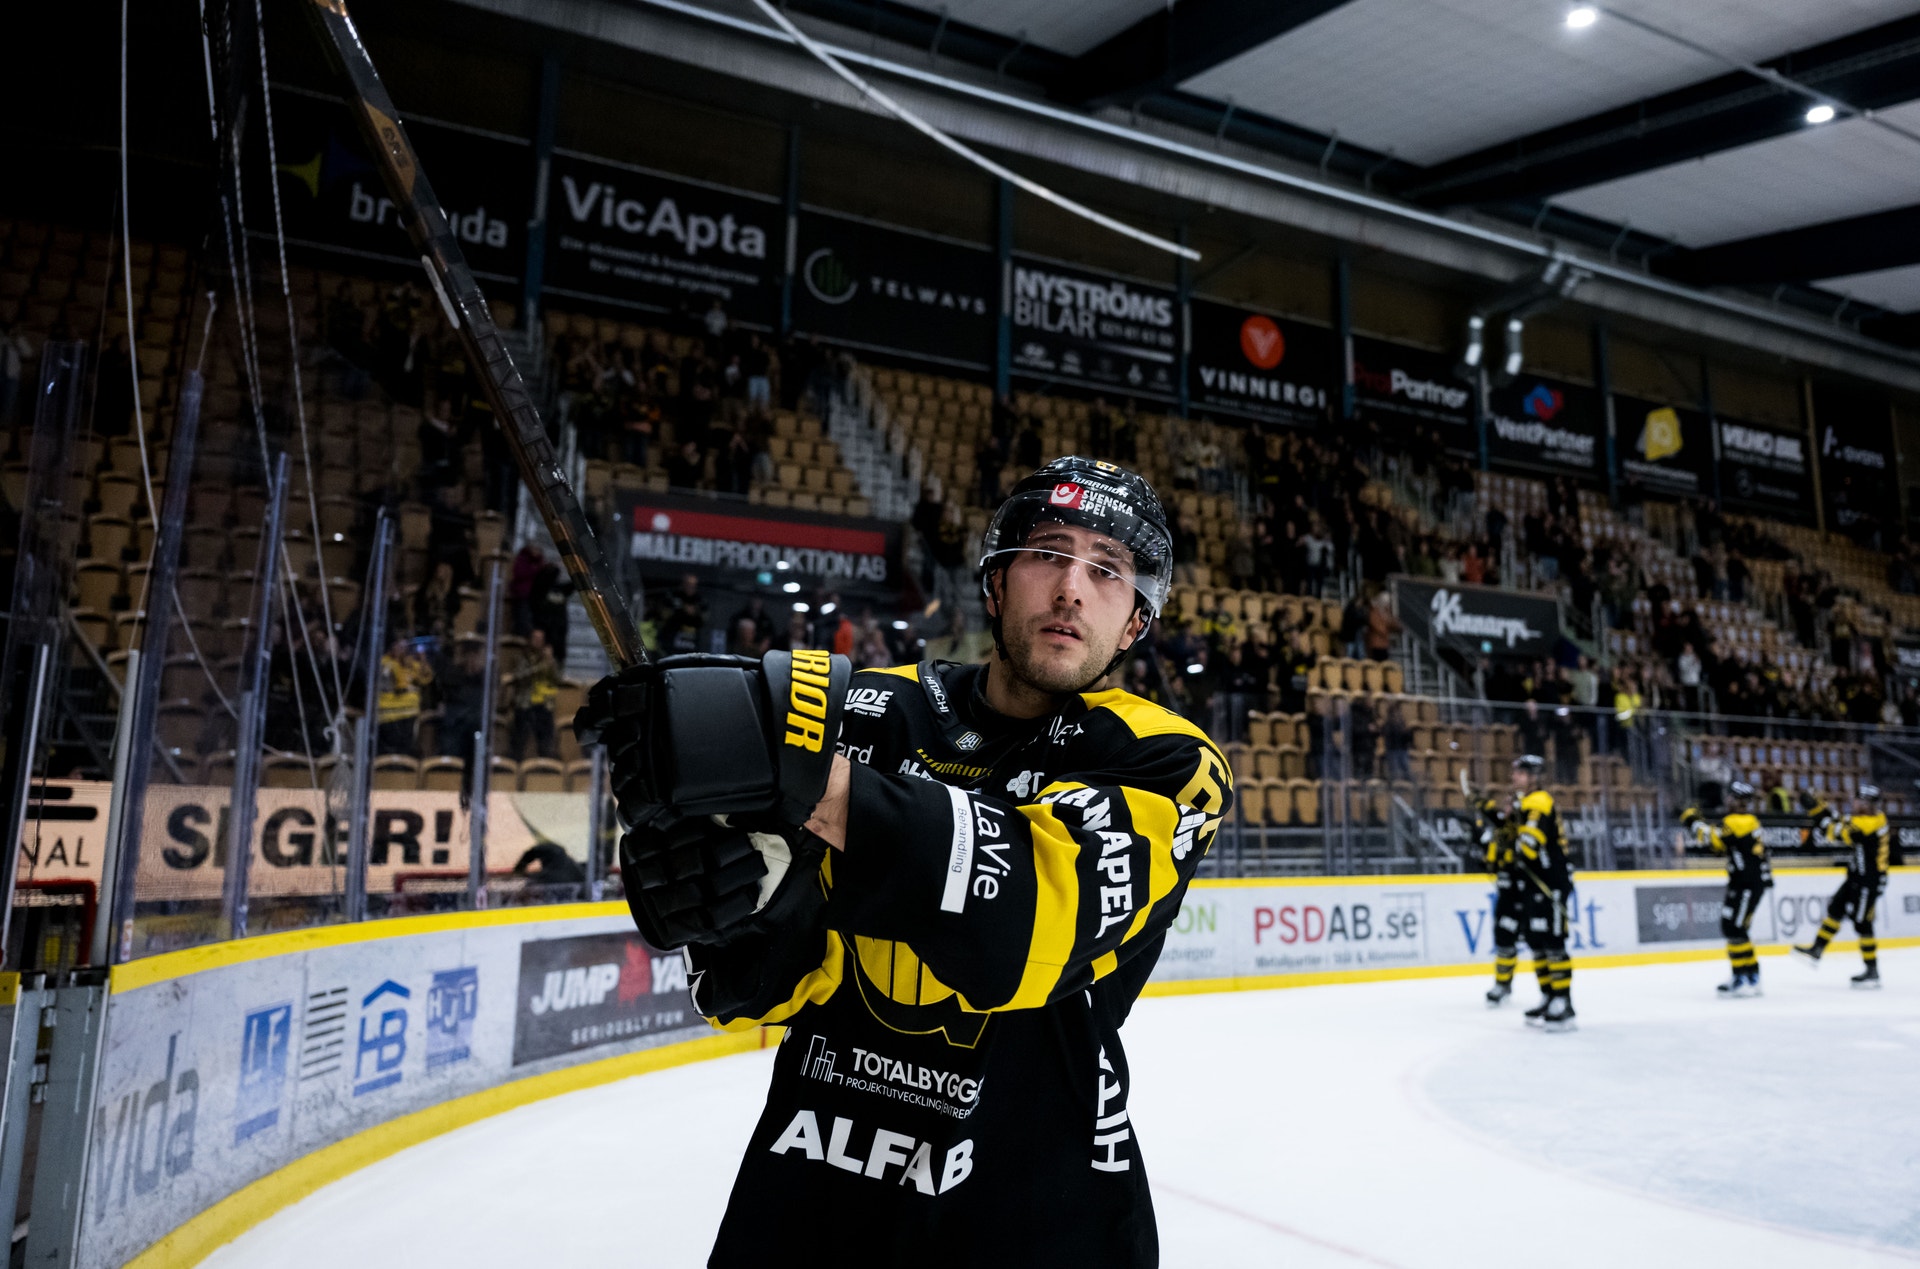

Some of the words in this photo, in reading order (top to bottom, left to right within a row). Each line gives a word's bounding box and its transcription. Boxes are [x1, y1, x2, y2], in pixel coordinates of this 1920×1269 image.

[349, 181, 509, 249] brda
[561, 174, 767, 261] VicApta
[869, 275, 987, 316] TELWAYS
[1013, 266, 1174, 328] NYSTRÖMS
[1013, 297, 1098, 341] BILAR
[1199, 364, 1327, 411] VINNERGI
[1071, 476, 1129, 498] WARRIOR
[1078, 500, 1106, 517] SPEL
[1081, 489, 1134, 517] SVENSKA
[856, 554, 888, 582] AB
[784, 649, 831, 754] RIOR
[924, 675, 950, 713] HITACHI
[162, 804, 454, 869] SGER!
[951, 808, 967, 874] Behandling
[973, 801, 1011, 900] LaVie
[1254, 904, 1419, 945] PSDAB.se
[530, 963, 620, 1015] JUMP
[571, 1016, 650, 1046] SERIOUSLY
[656, 1010, 684, 1026] FUN
[852, 1047, 984, 1103] TOTALBYGG
[95, 1033, 199, 1225] vida
[769, 1109, 975, 1197] ALFAB
